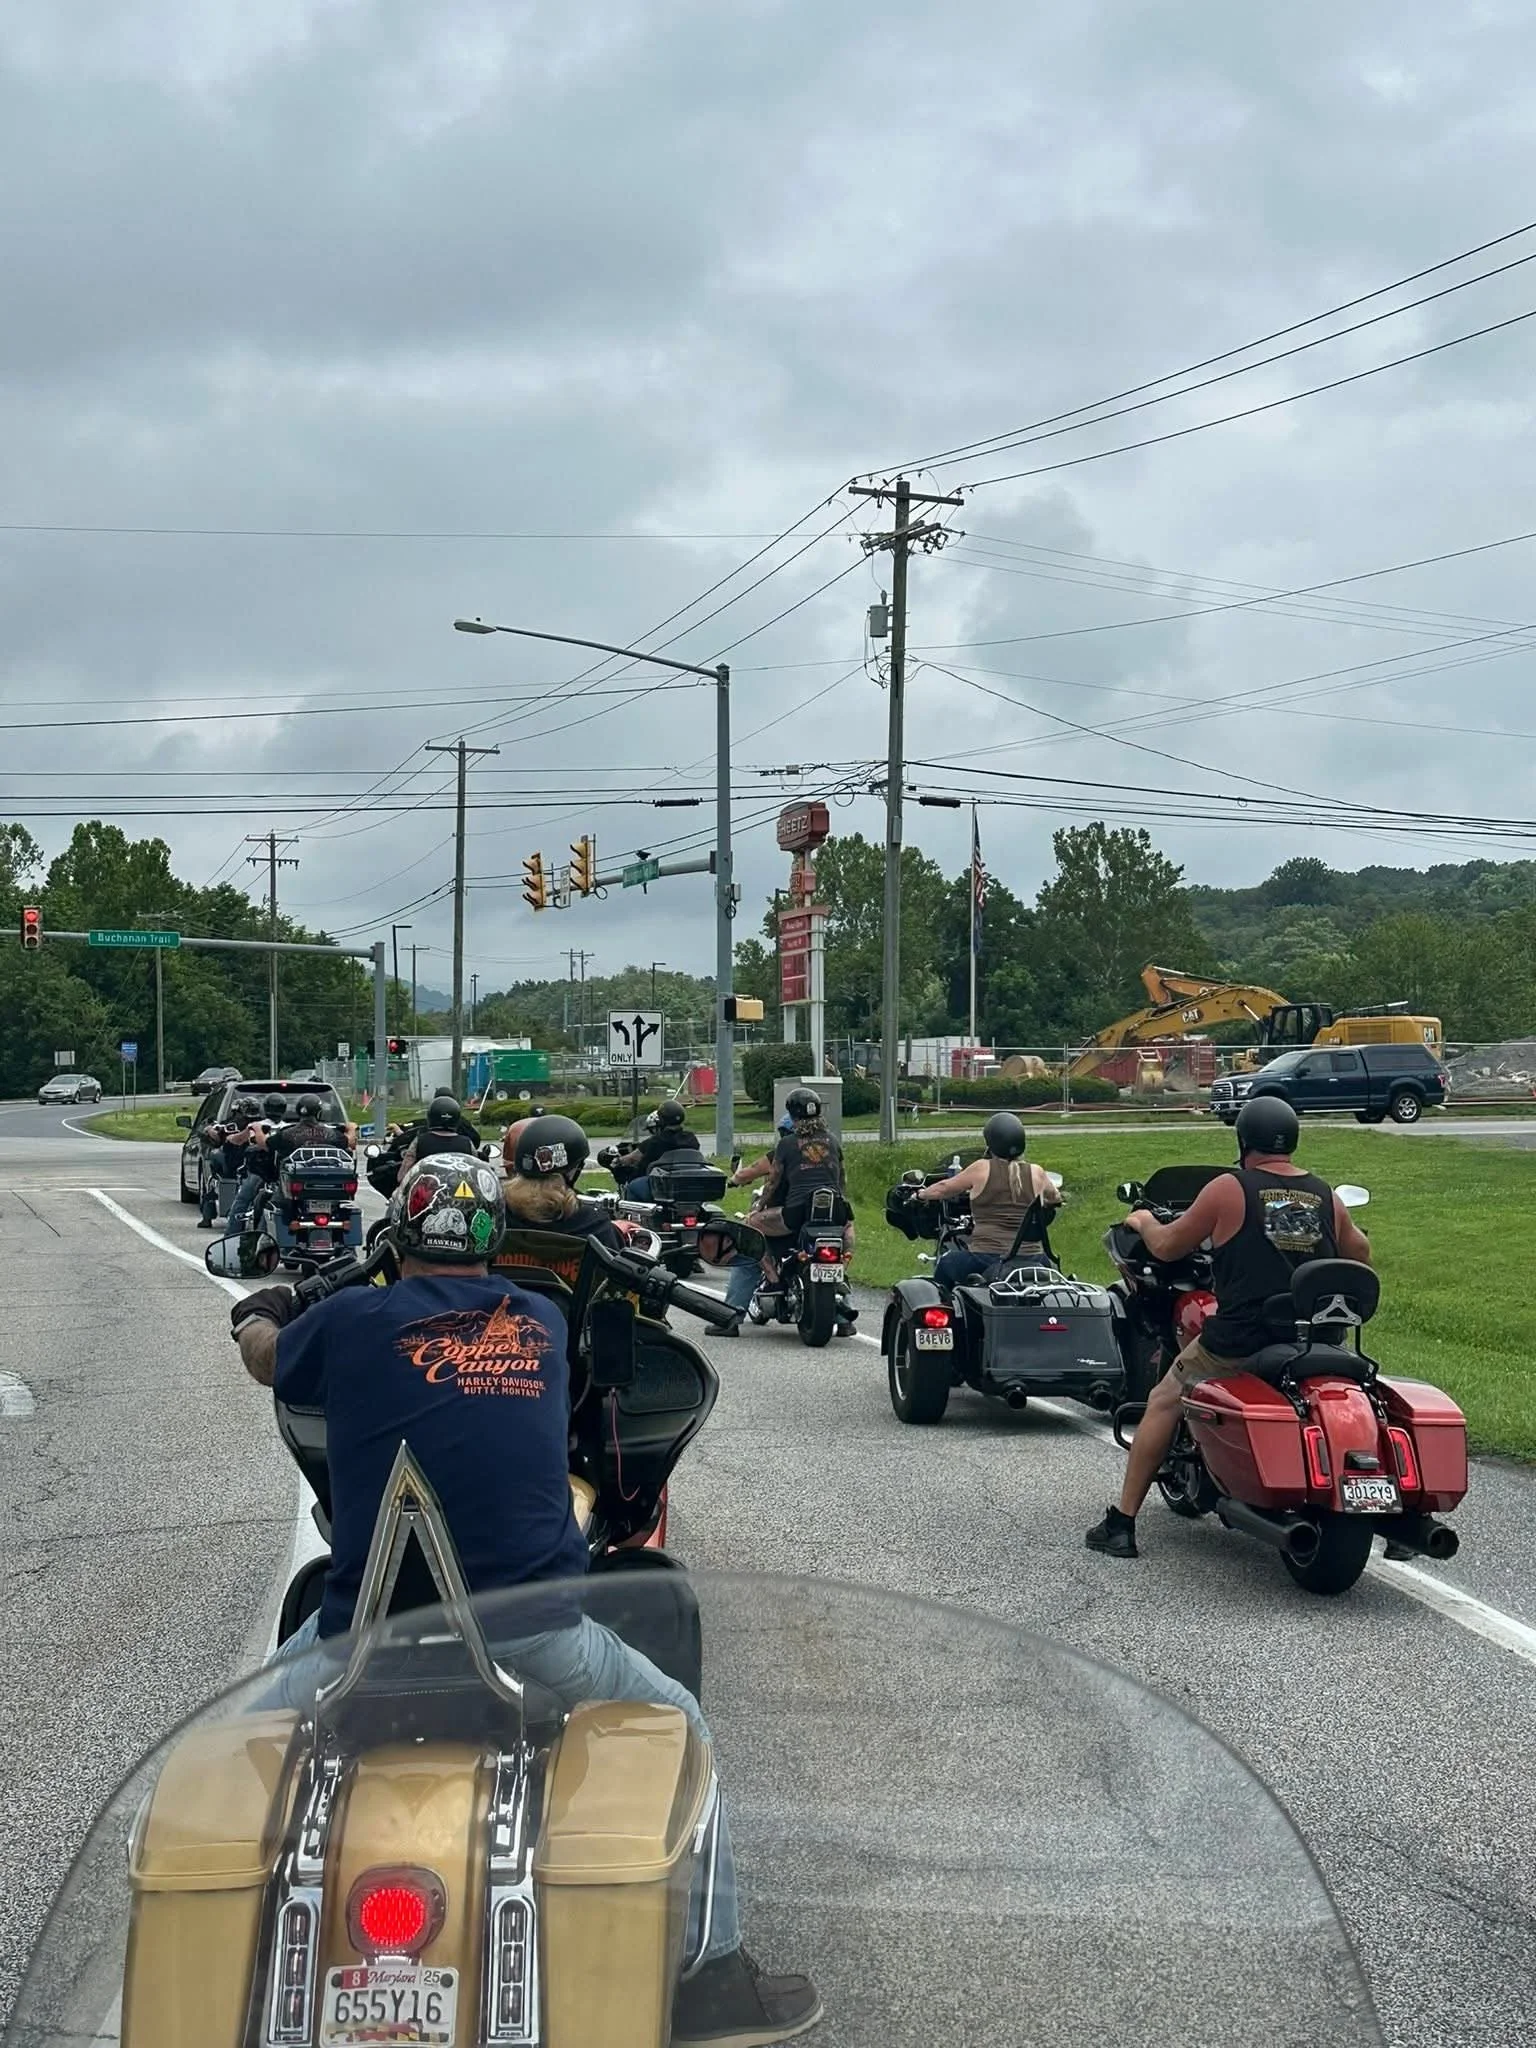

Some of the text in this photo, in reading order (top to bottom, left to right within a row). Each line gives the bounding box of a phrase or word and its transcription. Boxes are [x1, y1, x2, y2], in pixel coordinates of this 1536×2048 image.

[97, 932, 171, 944] Buchanan Trail
[1182, 1008, 1199, 1024] CAT
[611, 1053, 632, 1062] ONLY
[412, 1338, 521, 1366] Copper
[426, 1357, 540, 1383] Canyon
[501, 1387, 540, 1398] MONTANA
[1347, 1485, 1393, 1500] 3012Y9
[351, 1971, 361, 1986] 8
[423, 1970, 441, 1983] 25
[335, 1989, 442, 2023] 655Y16
